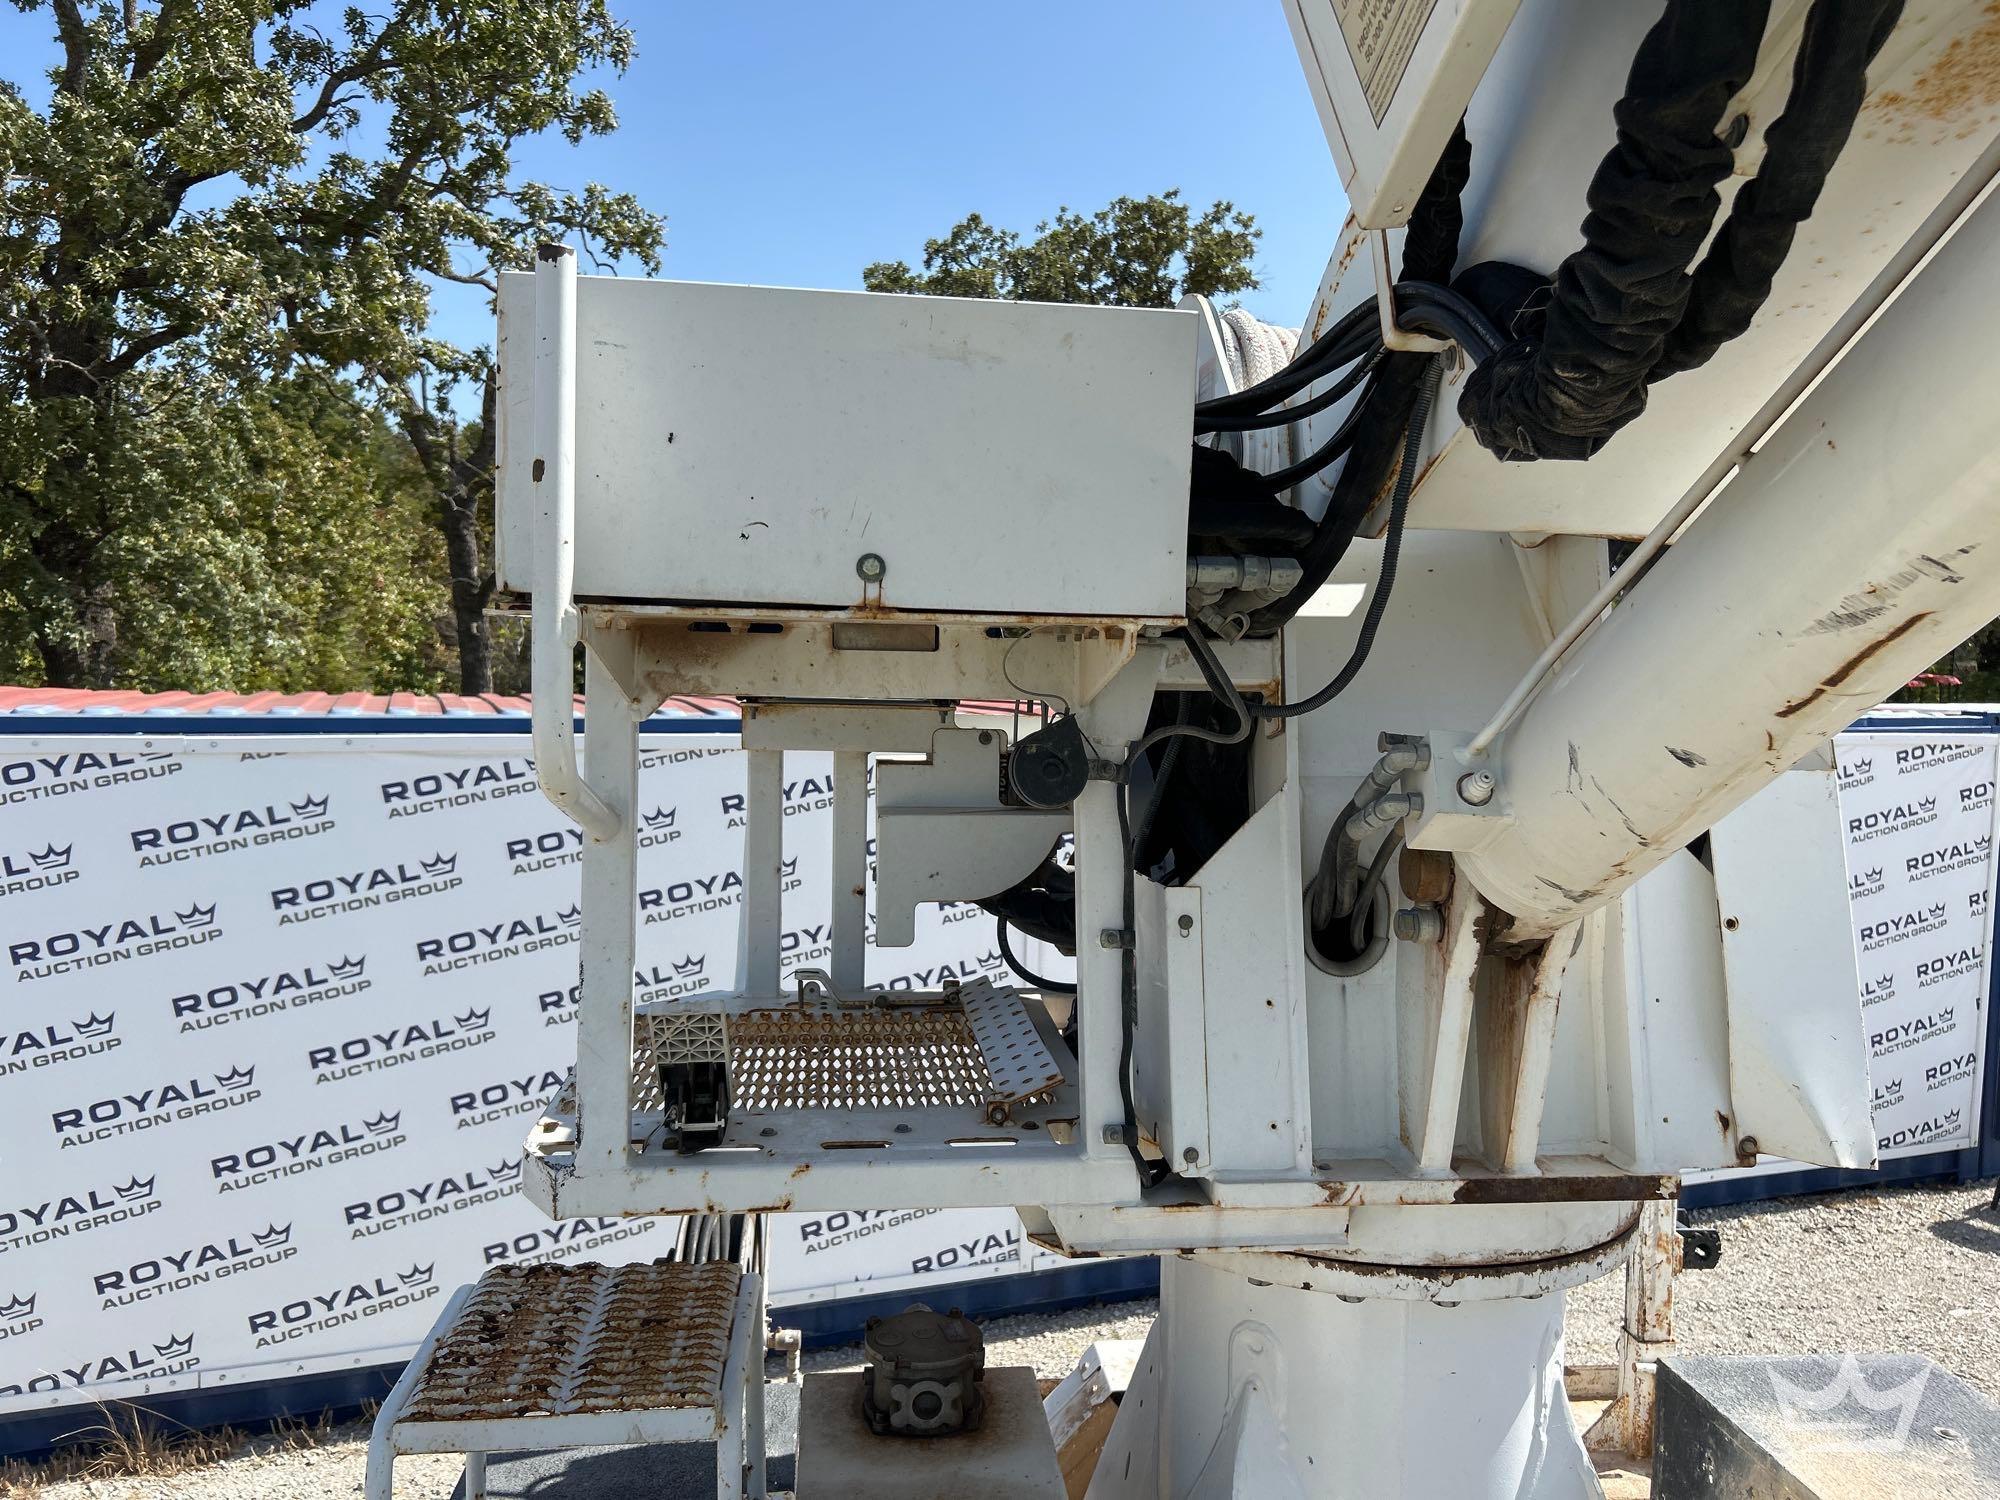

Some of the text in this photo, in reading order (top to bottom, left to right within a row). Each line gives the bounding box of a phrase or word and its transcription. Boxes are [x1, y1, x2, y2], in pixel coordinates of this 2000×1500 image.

[1, 752, 135, 786] OYAL
[638, 749, 704, 770] CTION
[1898, 746, 1984, 775] AUCTION GROUP
[0, 762, 183, 804] CTION GROUP
[381, 761, 526, 803] ROYAL
[388, 781, 541, 819] AUCTION GRO
[1849, 803, 1919, 833] ROYAL
[1961, 798, 1992, 813] AUCT
[130, 806, 291, 851] ROYAL
[139, 820, 336, 868] AUCTION GROUP
[506, 829, 583, 860] ROY
[637, 831, 682, 849] OUP
[1851, 814, 1938, 844] AUCTION GROUP
[513, 851, 583, 875] AUCTI
[1906, 843, 1974, 872] ROYAL
[1908, 864, 1955, 882] AUCTION
[271, 864, 421, 910] ROYAL
[278, 877, 463, 926] AUCTION GROUP
[639, 871, 742, 910] ROYA
[644, 895, 733, 925] AUCTION
[942, 907, 985, 924] AUCT
[1861, 910, 1929, 941] ROYAL
[9, 915, 176, 965] ROYAL
[416, 915, 558, 961] ROYAL
[423, 930, 581, 976] AUCTION GROU
[1863, 919, 1947, 952] AUCTION GROUP
[17, 928, 223, 982] AUCTION GROUP
[1917, 946, 1982, 978] ROYAL
[172, 968, 328, 1017] ROYAL
[640, 977, 711, 1003] GROUP
[1919, 968, 1964, 989] AUCTION
[180, 979, 372, 1033] AUCTION GROUP
[309, 1020, 455, 1069] ROYAL
[1871, 1015, 1938, 1048] ROYAL
[1872, 1023, 1957, 1059] AUCTION GROUP
[32, 1037, 122, 1067] GROUP
[316, 1030, 496, 1085] AUCTION GROUP
[1925, 1053, 1977, 1082] ROYA
[1927, 1069, 1971, 1092] AUCTION
[51, 1079, 216, 1133] ROYAL
[60, 1089, 262, 1149] AUCTION GROUP
[457, 1095, 551, 1129] AUCTION
[1872, 1095, 1905, 1112] ROUP
[211, 1125, 365, 1177] ROYAL
[1878, 1118, 1944, 1150] ROYAL
[1926, 1124, 1961, 1144] GROUP
[219, 1134, 407, 1194] AUCTION GROUP
[0, 1190, 115, 1235] YAL
[344, 1172, 488, 1225] ROYAL
[0, 1200, 162, 1254] TION GROUP
[351, 1203, 449, 1240] AUCTION
[801, 1210, 902, 1241] ROY
[805, 1207, 945, 1255] AUCTION GROU
[511, 1221, 656, 1268] CTION GROUP
[912, 1229, 1020, 1273] ROYAL
[93, 1238, 254, 1295] ROYAL
[102, 1246, 298, 1311] AUCTION GROUP
[248, 1278, 398, 1334] ROYAL
[256, 1285, 440, 1349] AUCTION GROUP
